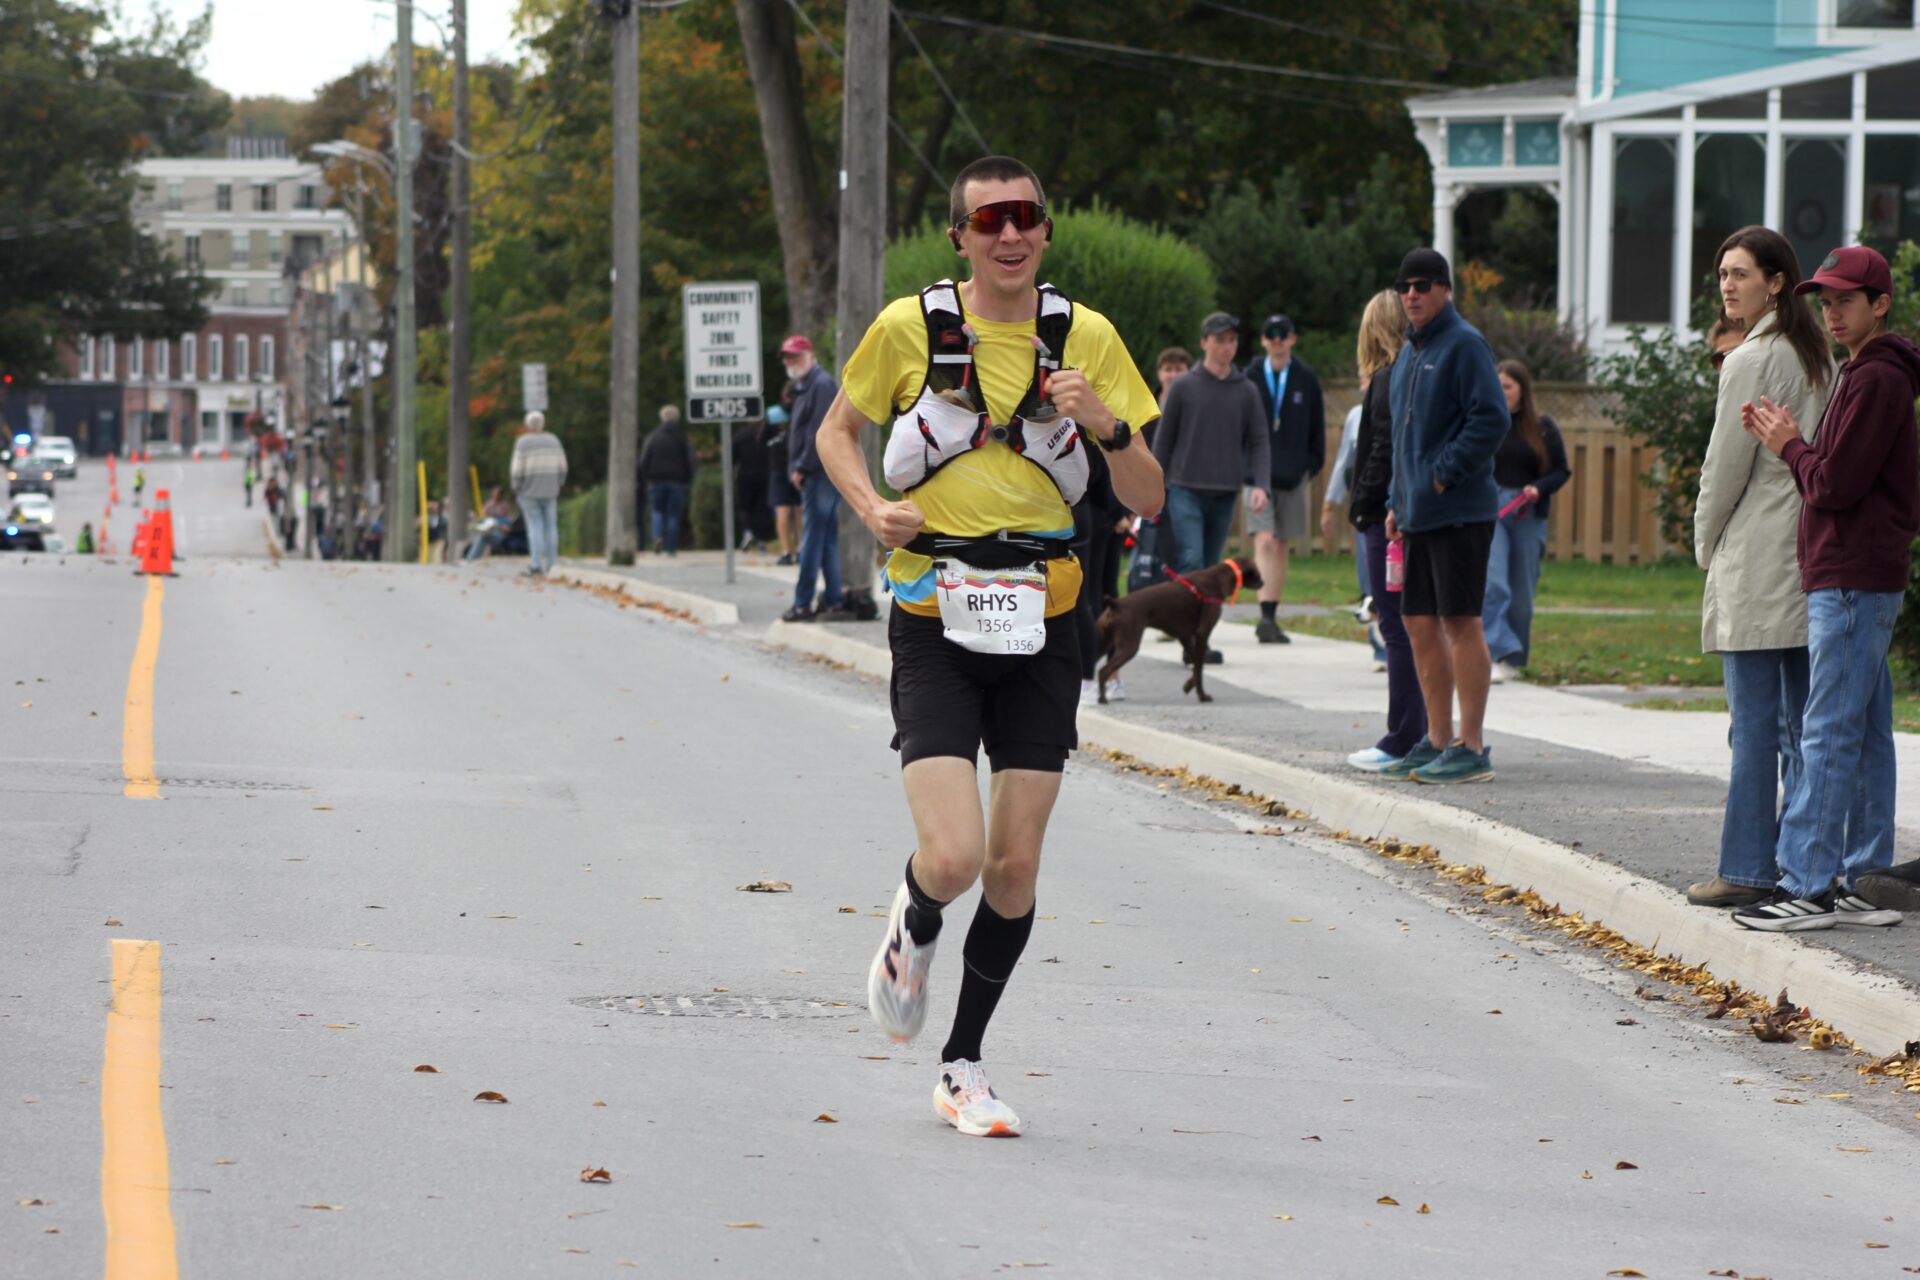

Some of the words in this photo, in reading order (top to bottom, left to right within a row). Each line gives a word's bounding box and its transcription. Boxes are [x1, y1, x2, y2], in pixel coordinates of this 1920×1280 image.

[689, 291, 754, 306] COMMUNITY
[702, 312, 740, 327] SAFETY
[710, 333, 735, 345] ZONE
[709, 354, 738, 367] FINES
[695, 374, 753, 388] INCREASED
[703, 399, 748, 417] ENDS
[1047, 419, 1073, 450] USWE
[967, 594, 1018, 611] RHYS
[977, 619, 1012, 633] 1356
[1006, 639, 1034, 651] 1356
